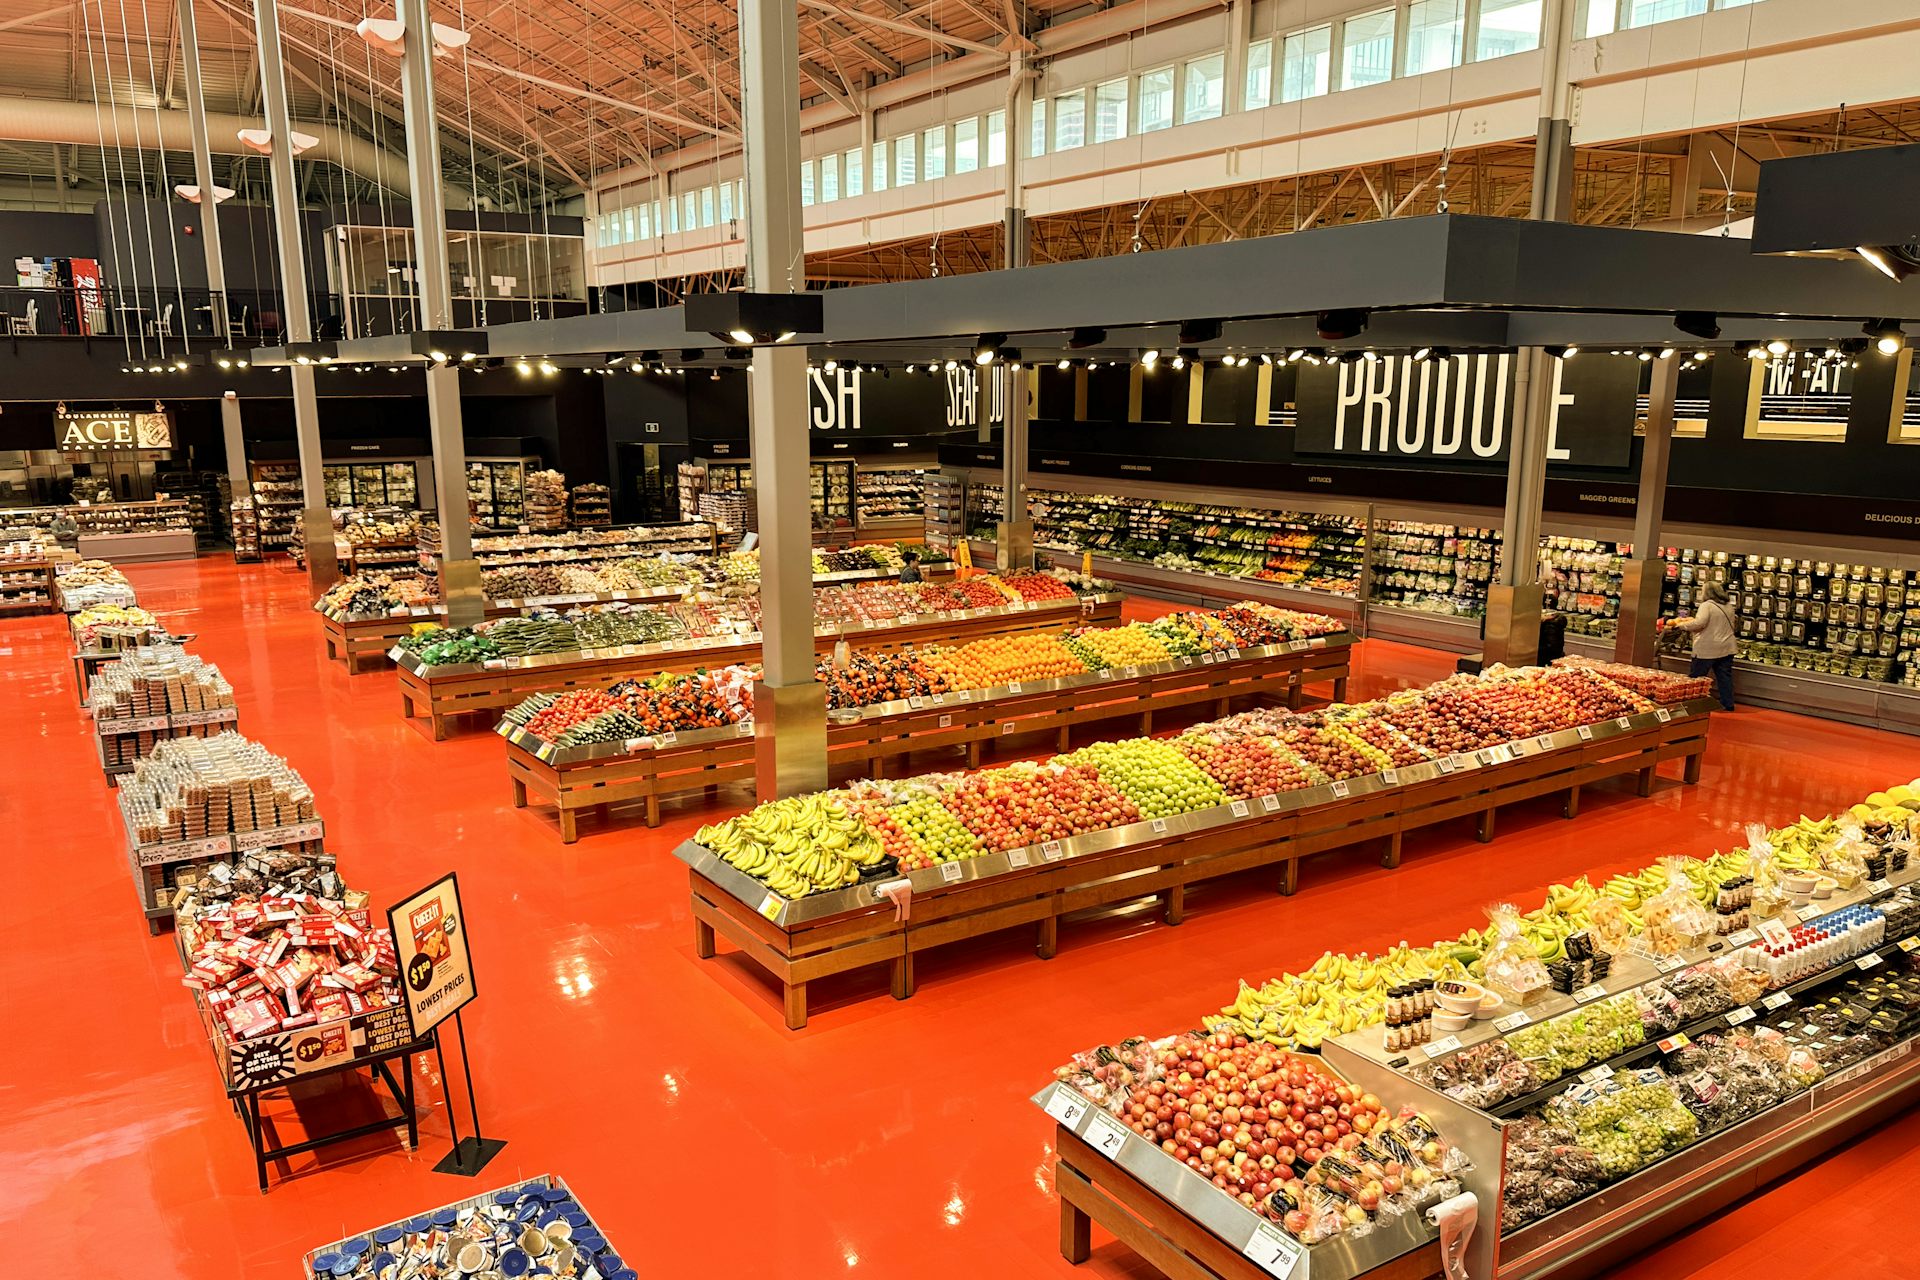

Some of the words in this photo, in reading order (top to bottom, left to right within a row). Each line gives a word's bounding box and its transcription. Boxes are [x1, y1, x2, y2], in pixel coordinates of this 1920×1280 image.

[1769, 352, 1844, 395] MAT
[1334, 353, 1575, 460] PRODUE
[62, 420, 133, 444] ACE
[62, 443, 133, 451] BAKERY
[1308, 476, 1332, 484] LETTUCES
[1579, 494, 1607, 502] BAGGED
[1608, 495, 1637, 504] GREENS
[1865, 513, 1913, 524] DELICIOUS
[416, 988, 443, 1014] LOWEST
[443, 973, 465, 995] PRICES
[366, 1010, 394, 1023] LOWEST
[395, 1007, 406, 1016] PR
[373, 1018, 391, 1029] BEST
[392, 1014, 408, 1024] DEA
[368, 1025, 396, 1038] LOWEST
[397, 1021, 410, 1031] PRI
[370, 1039, 398, 1053] LOWEST
[398, 1035, 412, 1046] PRI
[375, 1033, 393, 1043] BEST
[245, 1059, 259, 1067] OF
[260, 1054, 279, 1063] THE
[253, 1050, 270, 1059] HIT
[246, 1060, 281, 1075] MONTH
